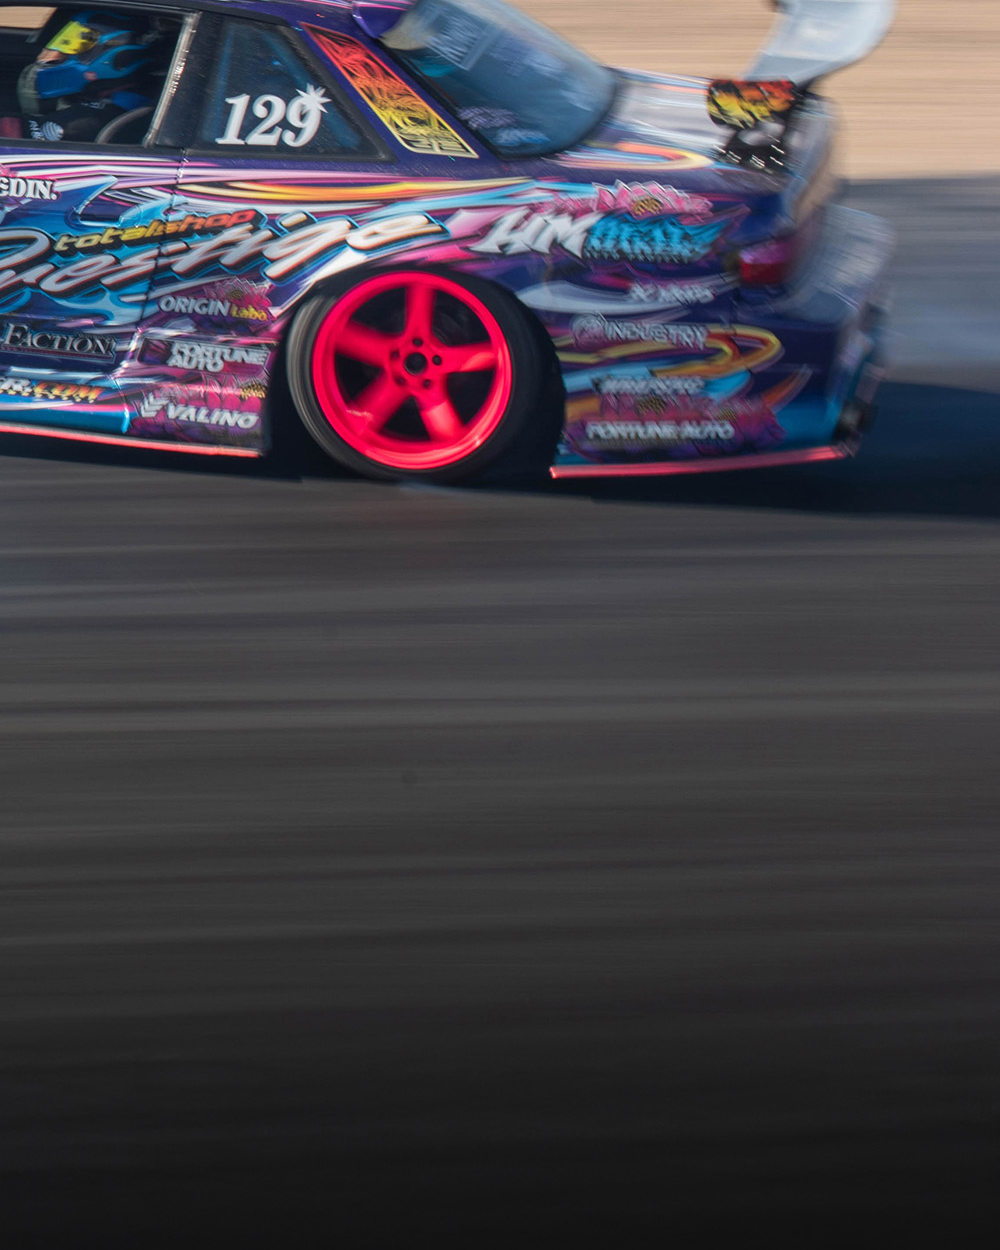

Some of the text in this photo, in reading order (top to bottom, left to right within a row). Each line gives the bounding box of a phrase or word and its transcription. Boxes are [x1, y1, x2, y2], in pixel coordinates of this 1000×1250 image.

[215, 87, 326, 147] 129
[159, 296, 230, 317] ORIGIN
[167, 354, 225, 372] AUTO
[172, 343, 269, 366] FORTUNE
[167, 403, 260, 429] VALINO
